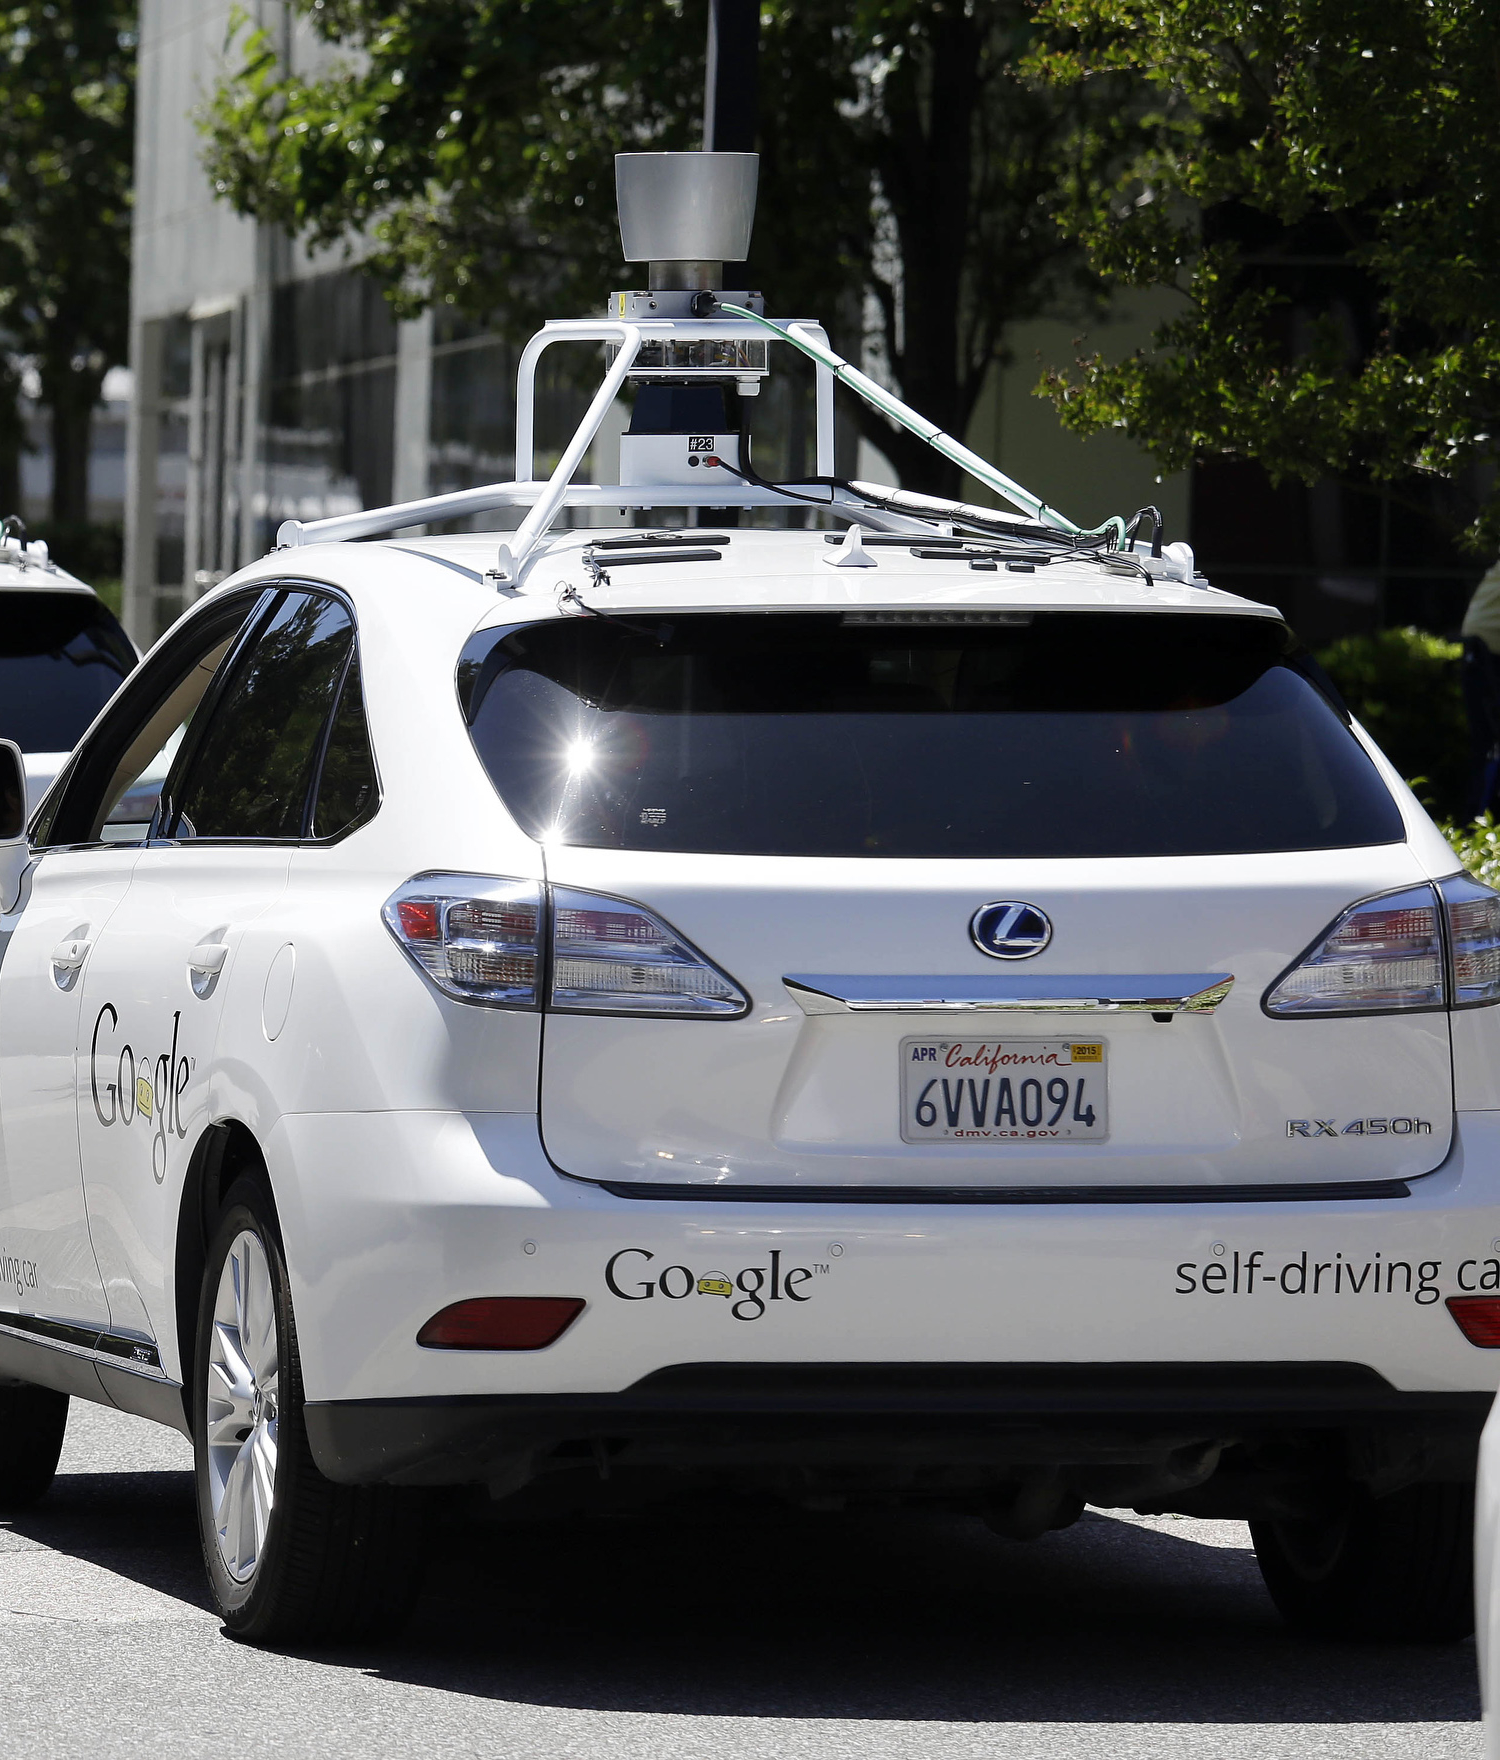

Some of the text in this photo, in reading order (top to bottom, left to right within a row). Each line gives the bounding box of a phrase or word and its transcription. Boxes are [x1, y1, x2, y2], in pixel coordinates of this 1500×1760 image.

[689, 438, 714, 451] #23
[911, 1043, 1096, 1075] APR California 2015
[915, 1077, 1096, 1128] 6VVA094
[954, 1129, 1060, 1138] dmv.ca.gov
[22, 1259, 39, 1289] car
[1175, 1251, 1442, 1305] self-driving
